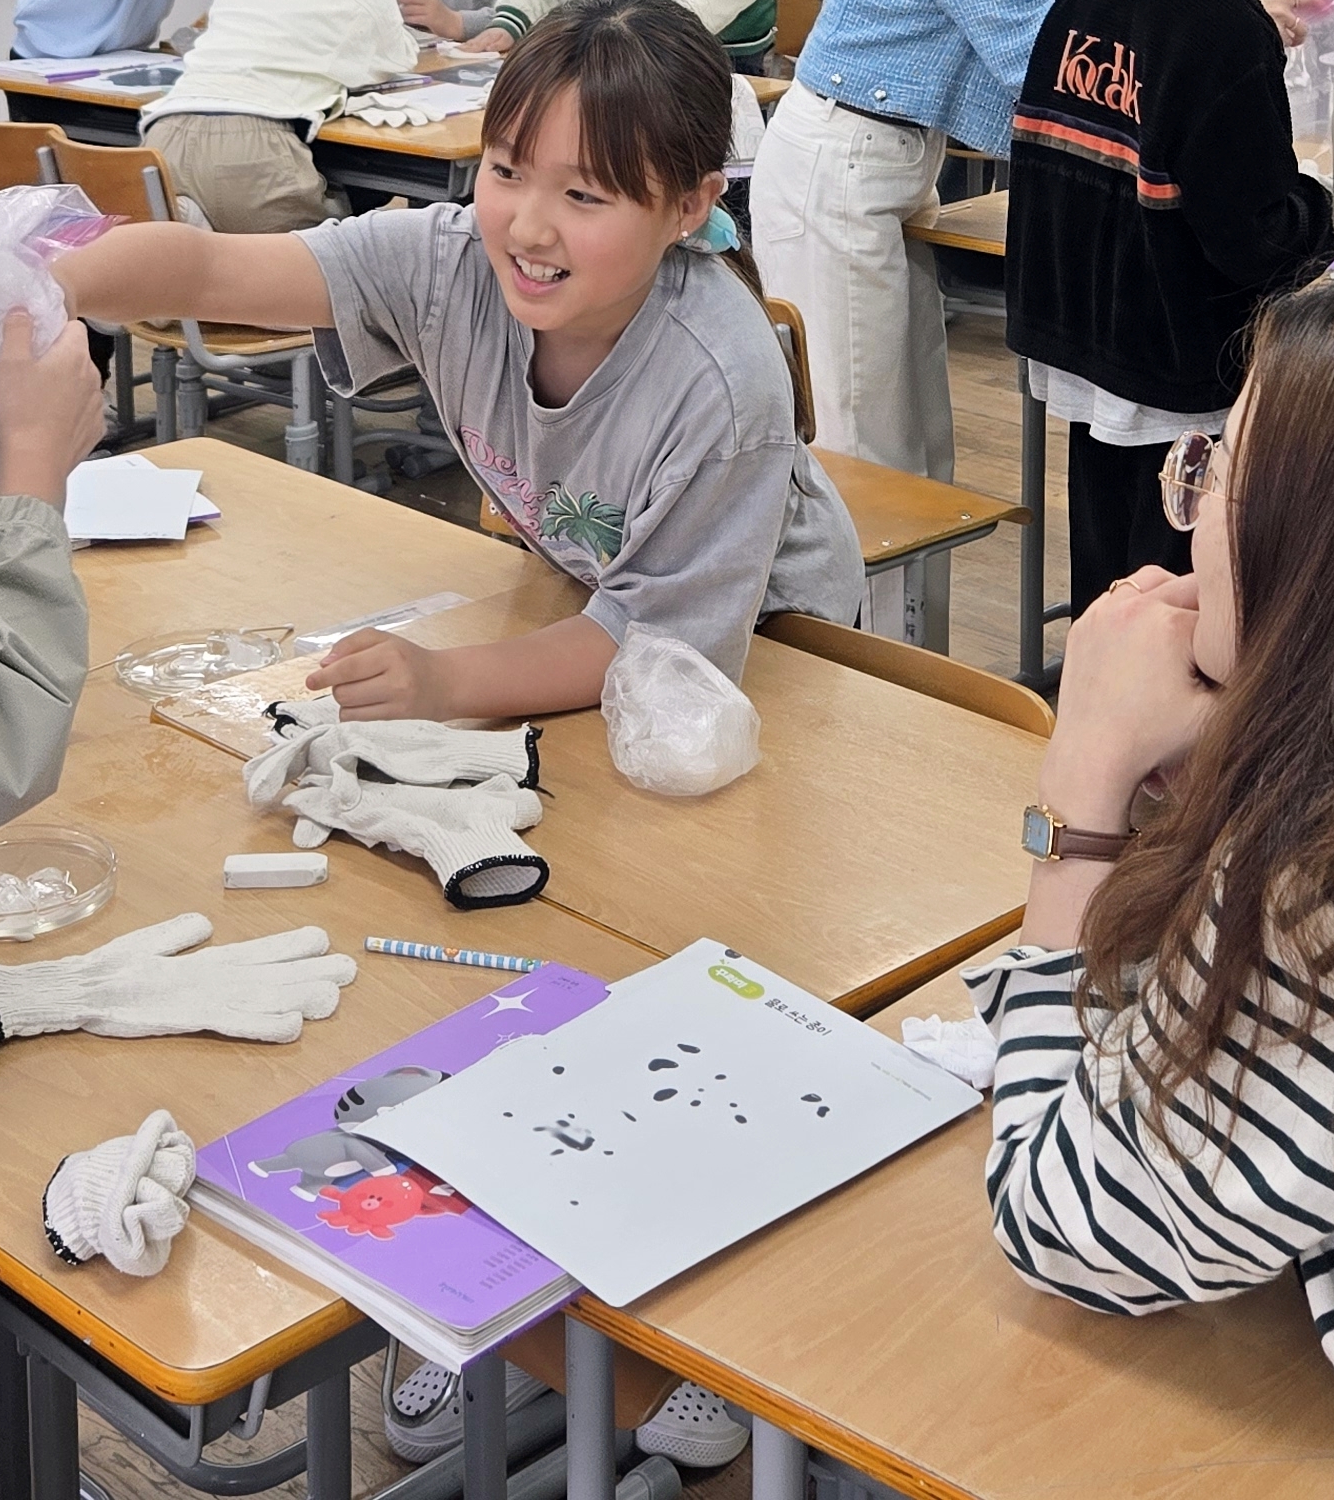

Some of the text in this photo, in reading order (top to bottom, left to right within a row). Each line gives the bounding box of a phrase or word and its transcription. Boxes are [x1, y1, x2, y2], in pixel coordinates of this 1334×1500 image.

[1054, 29, 1143, 125] Kodak
[785, 1010, 808, 1025] 쓰는
[806, 1020, 832, 1037] 종이
